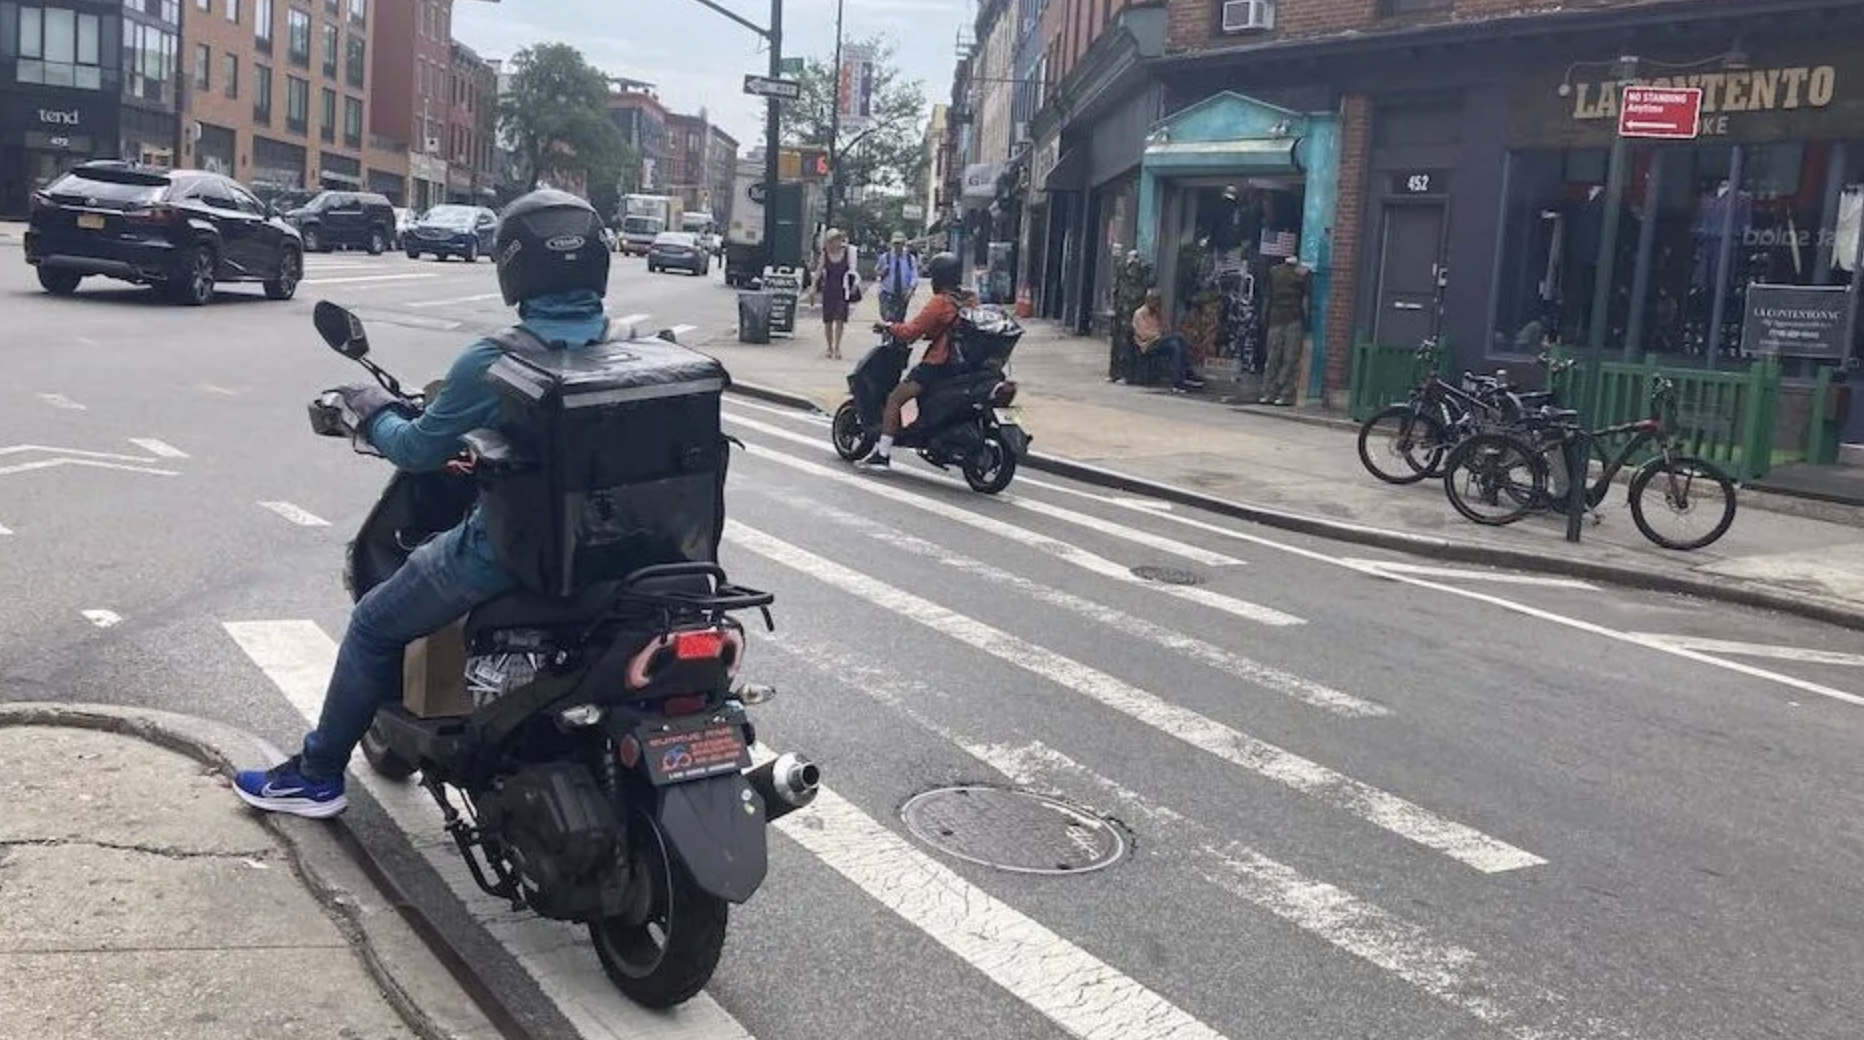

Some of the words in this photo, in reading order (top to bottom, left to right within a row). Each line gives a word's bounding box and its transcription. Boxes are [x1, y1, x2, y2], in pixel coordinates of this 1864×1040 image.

[1573, 82, 1617, 119] LA
[1638, 65, 1836, 113] TENTO
[1628, 91, 1641, 102] NO
[1642, 91, 1687, 104] STANDING
[1626, 103, 1664, 114] Anytime
[39, 109, 79, 125] tend
[1407, 175, 1430, 191] 452
